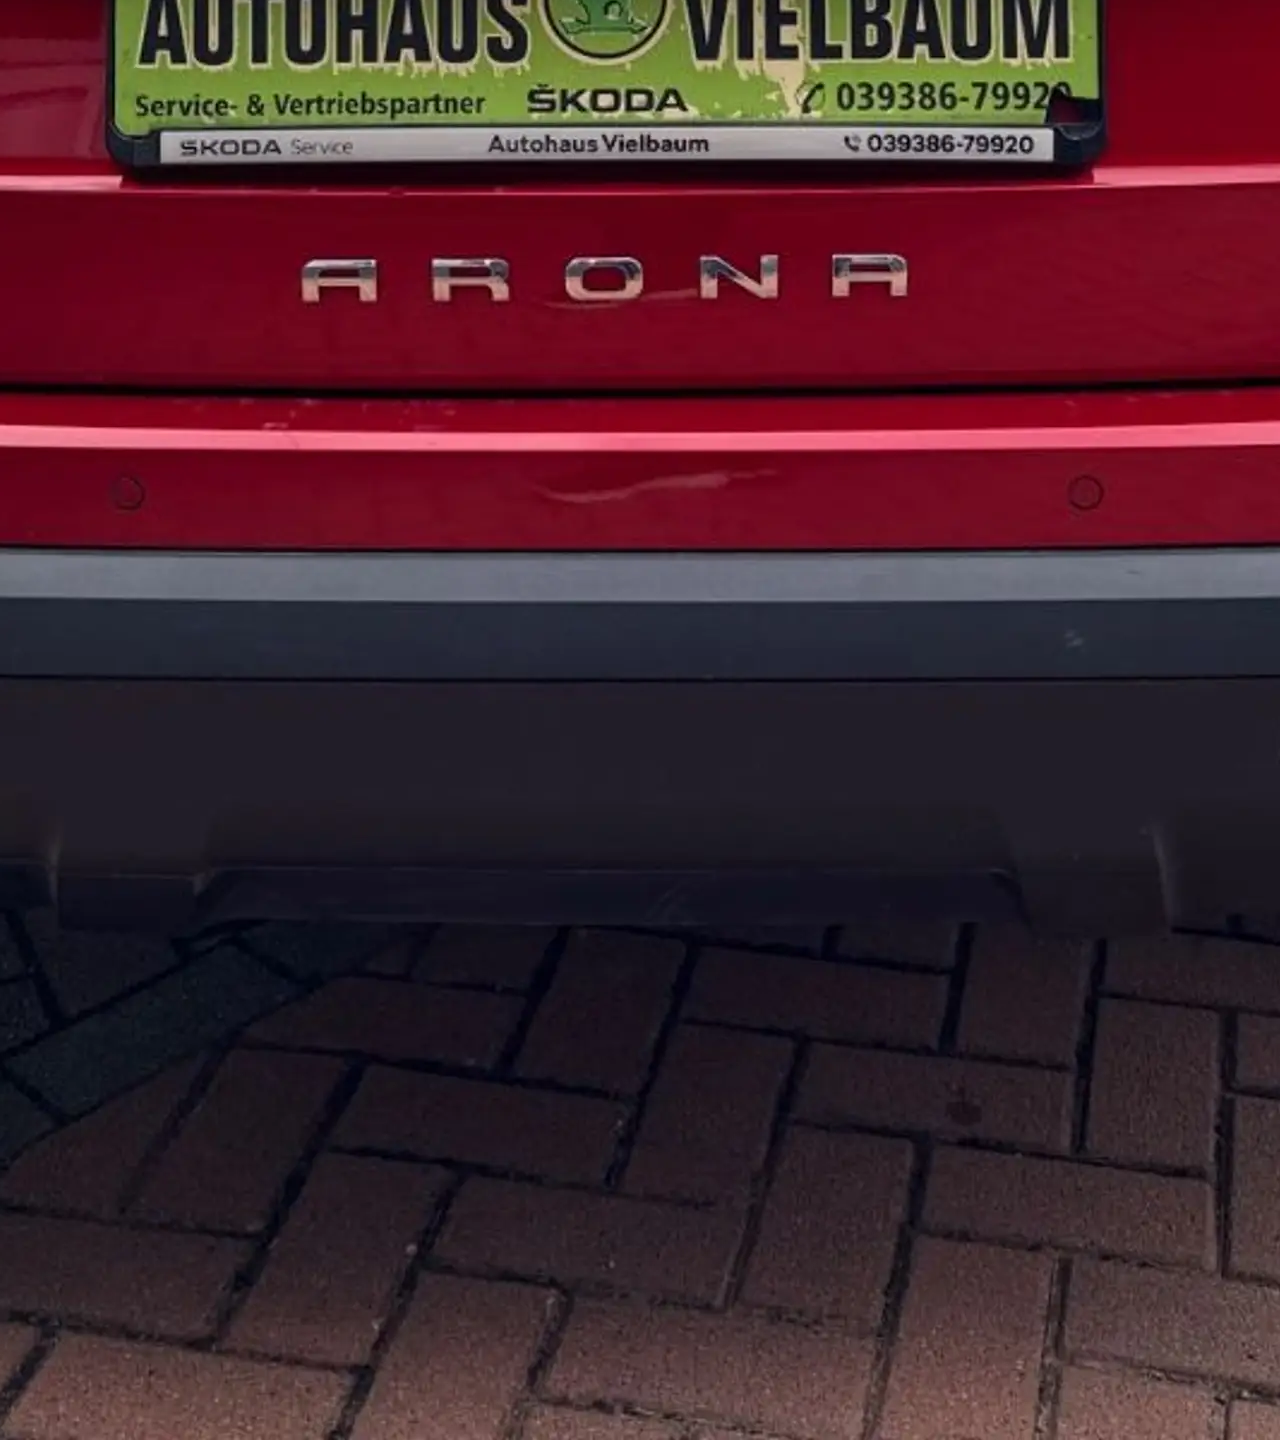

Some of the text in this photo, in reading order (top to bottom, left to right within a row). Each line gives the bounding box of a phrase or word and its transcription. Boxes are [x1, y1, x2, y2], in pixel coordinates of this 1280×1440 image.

[135, 91, 485, 119] Service- & Vertriebspartner
[291, 138, 354, 155] Service
[488, 133, 709, 153] Autohaus Vielbaum
[867, 133, 1034, 154] 039386-79920
[301, 254, 908, 302] ARONA
